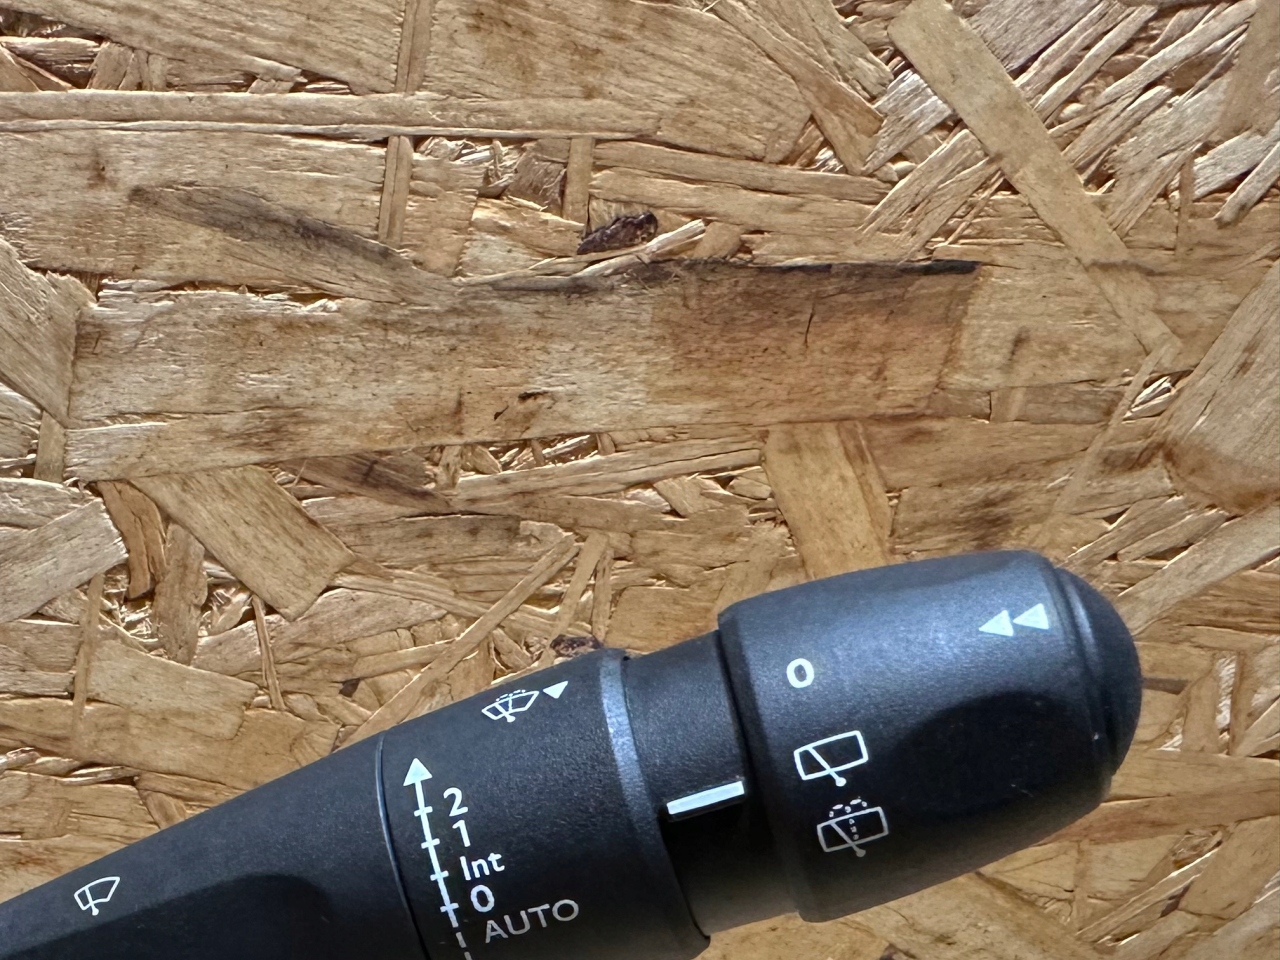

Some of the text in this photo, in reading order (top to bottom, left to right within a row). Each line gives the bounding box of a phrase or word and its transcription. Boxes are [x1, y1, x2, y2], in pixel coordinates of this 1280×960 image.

[443, 787, 469, 817] 2
[452, 819, 471, 848] 1
[459, 852, 506, 881] Int
[484, 898, 580, 944] AUTO
